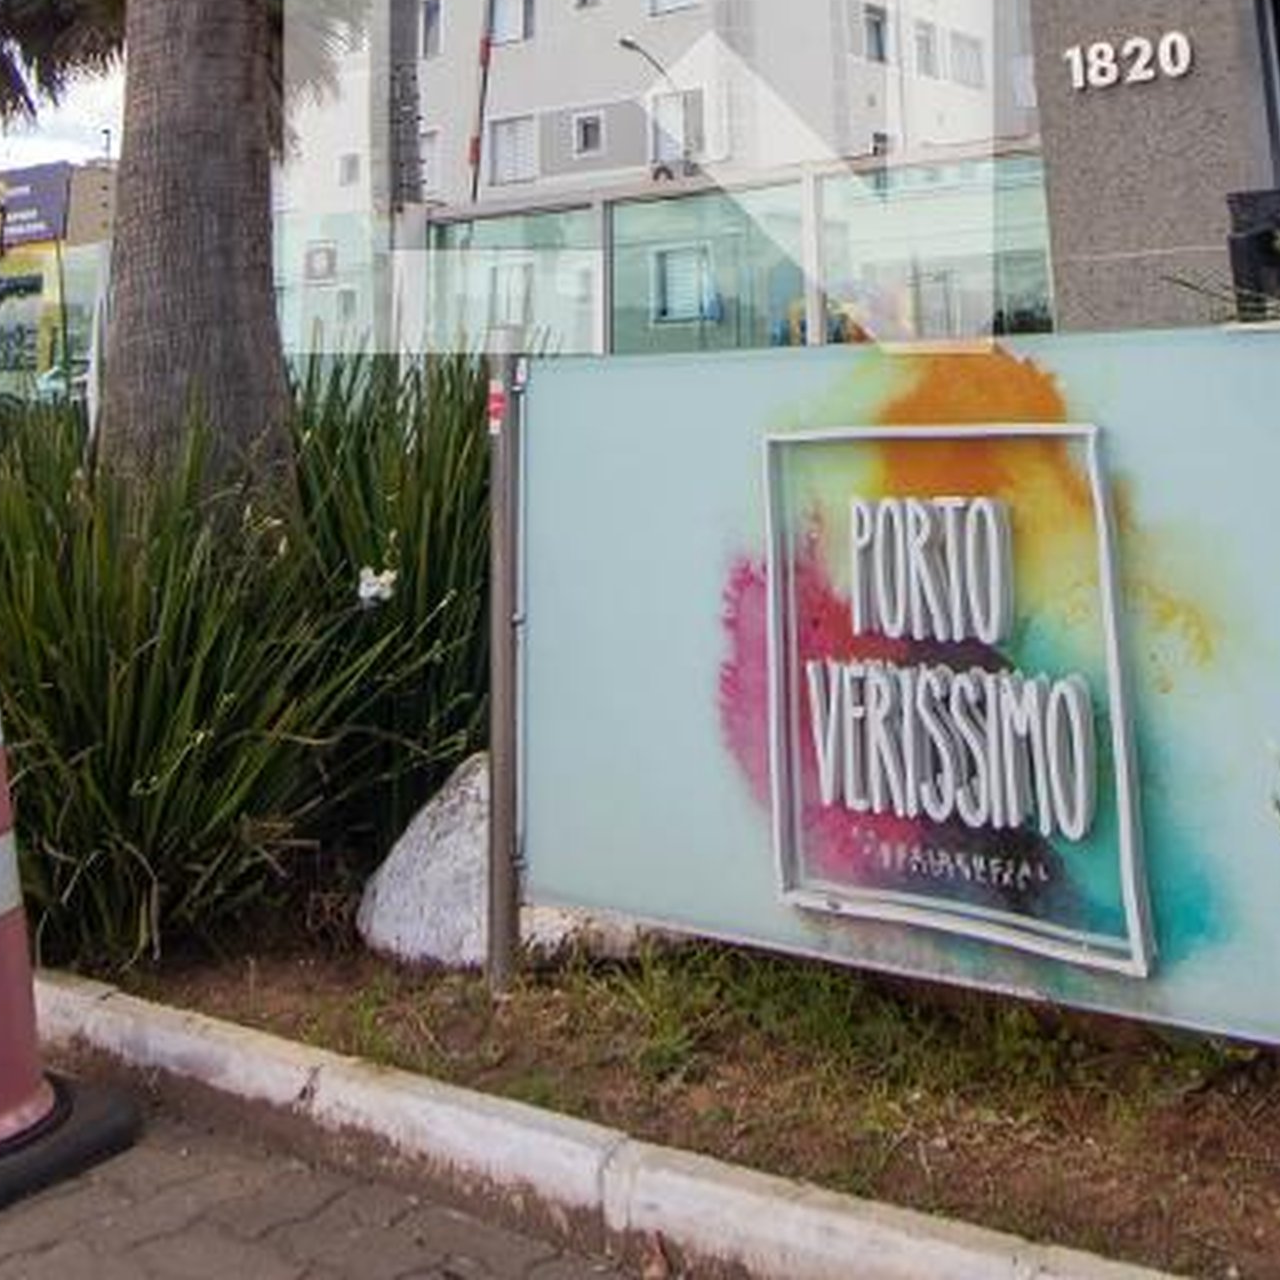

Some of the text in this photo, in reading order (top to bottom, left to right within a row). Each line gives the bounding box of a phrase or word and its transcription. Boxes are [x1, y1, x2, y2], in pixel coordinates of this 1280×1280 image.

[1063, 30, 1192, 89] 1820
[850, 495, 1006, 645] PORTO
[805, 658, 1092, 841] VERISSIMO
